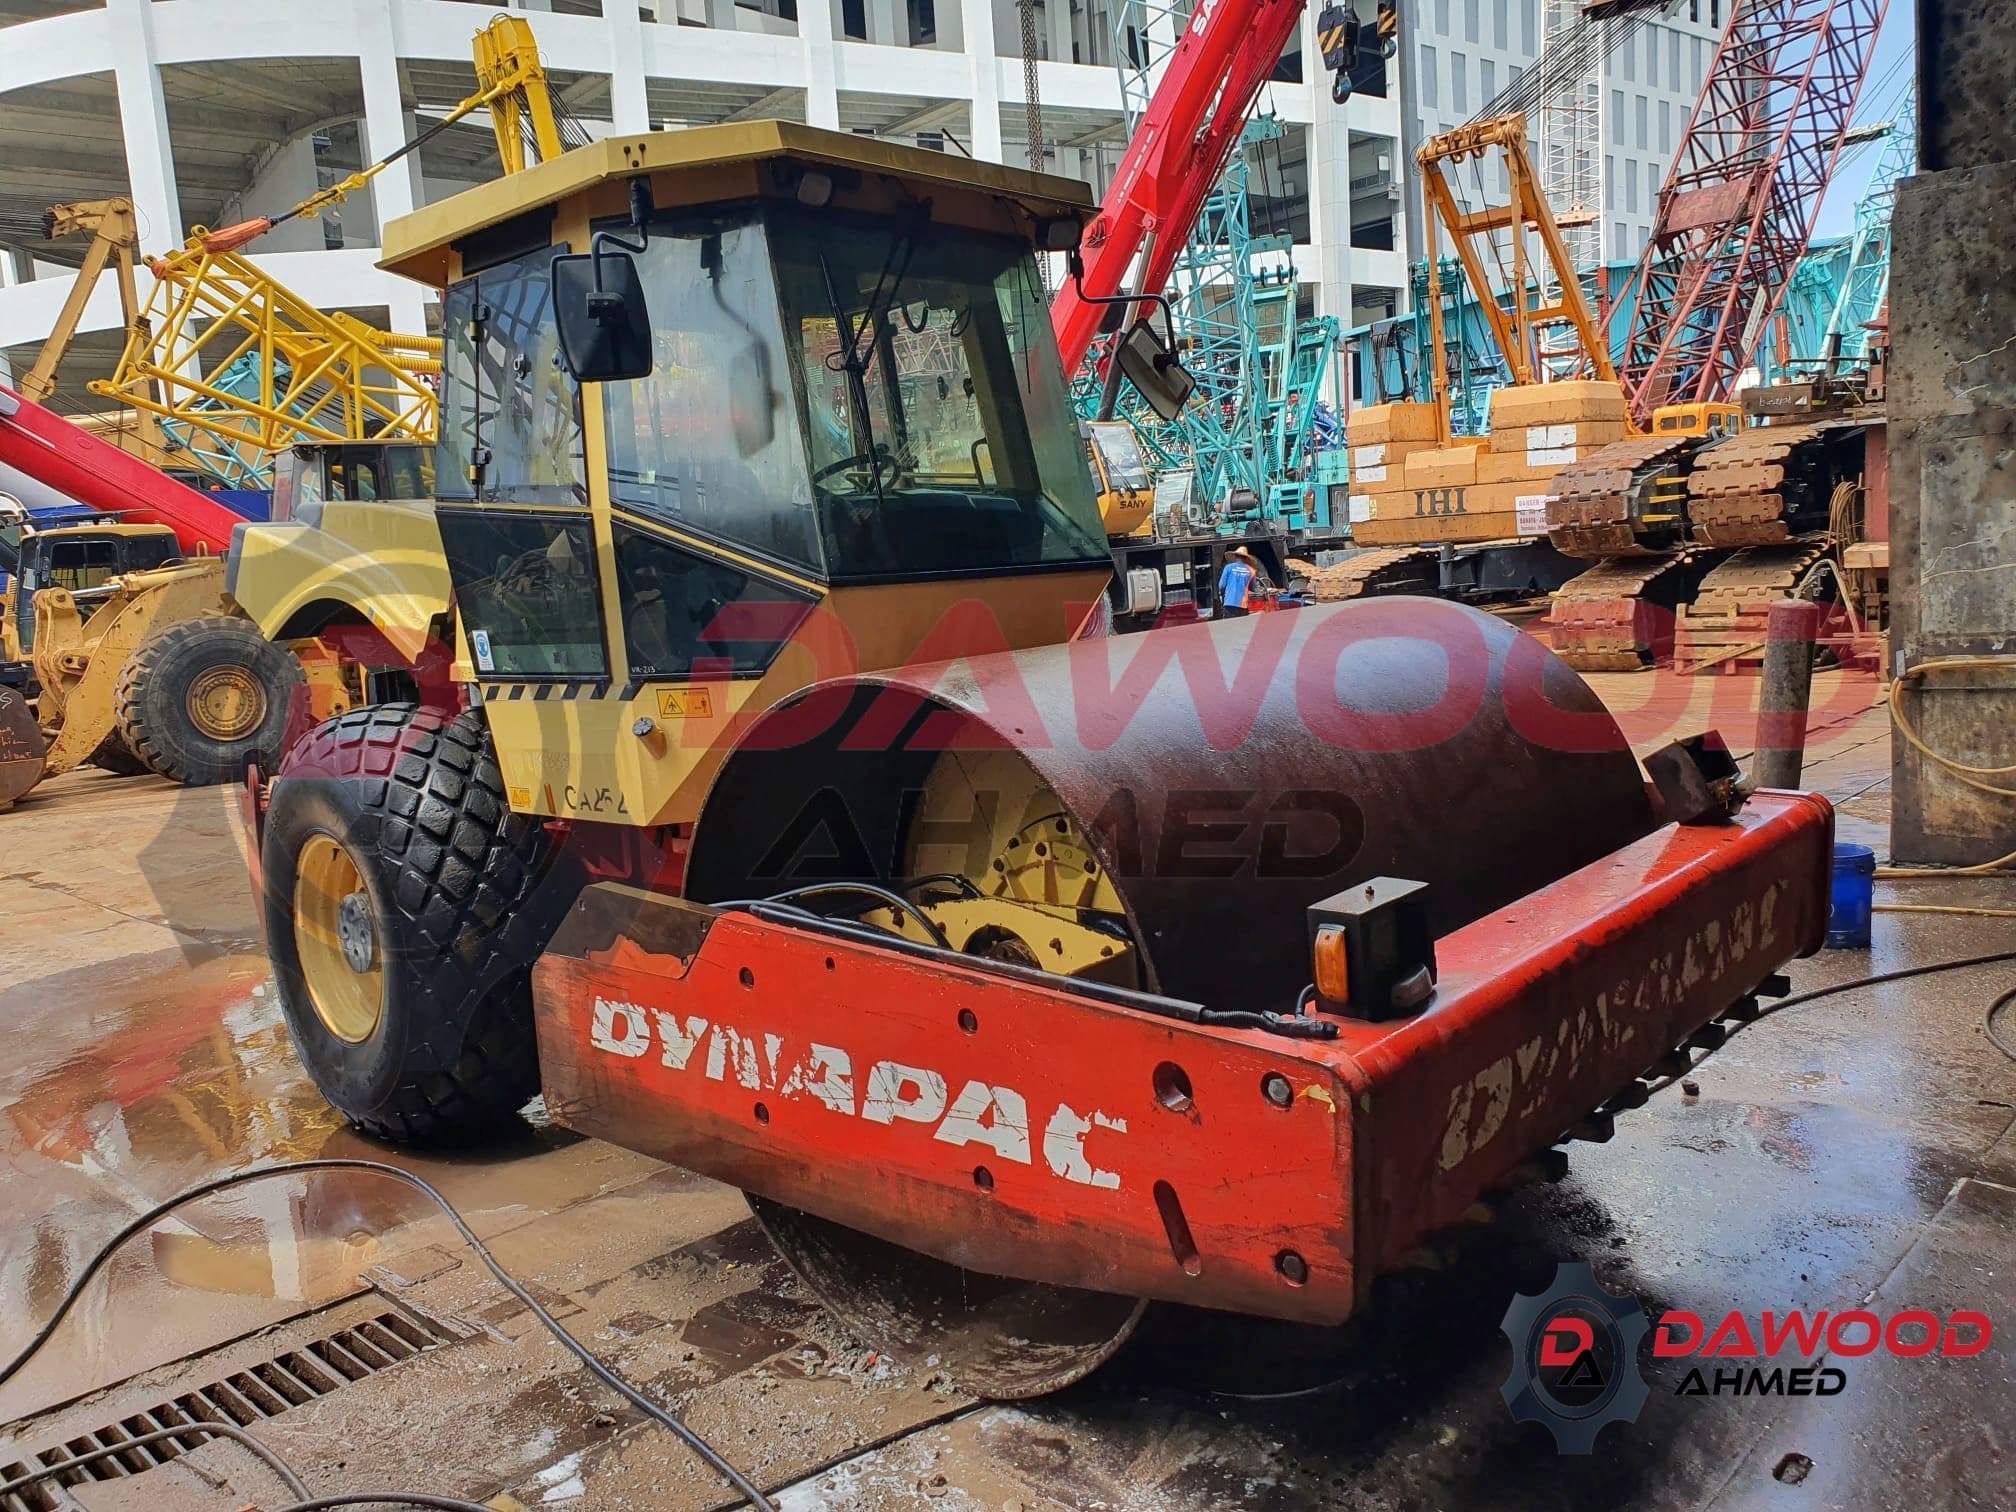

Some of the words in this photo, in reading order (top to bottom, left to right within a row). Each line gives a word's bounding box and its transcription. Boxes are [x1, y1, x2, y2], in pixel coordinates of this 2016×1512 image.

[1119, 500, 1147, 510] SANY
[1414, 487, 1467, 515] IHI
[591, 996, 1128, 1190] DYNAPAC
